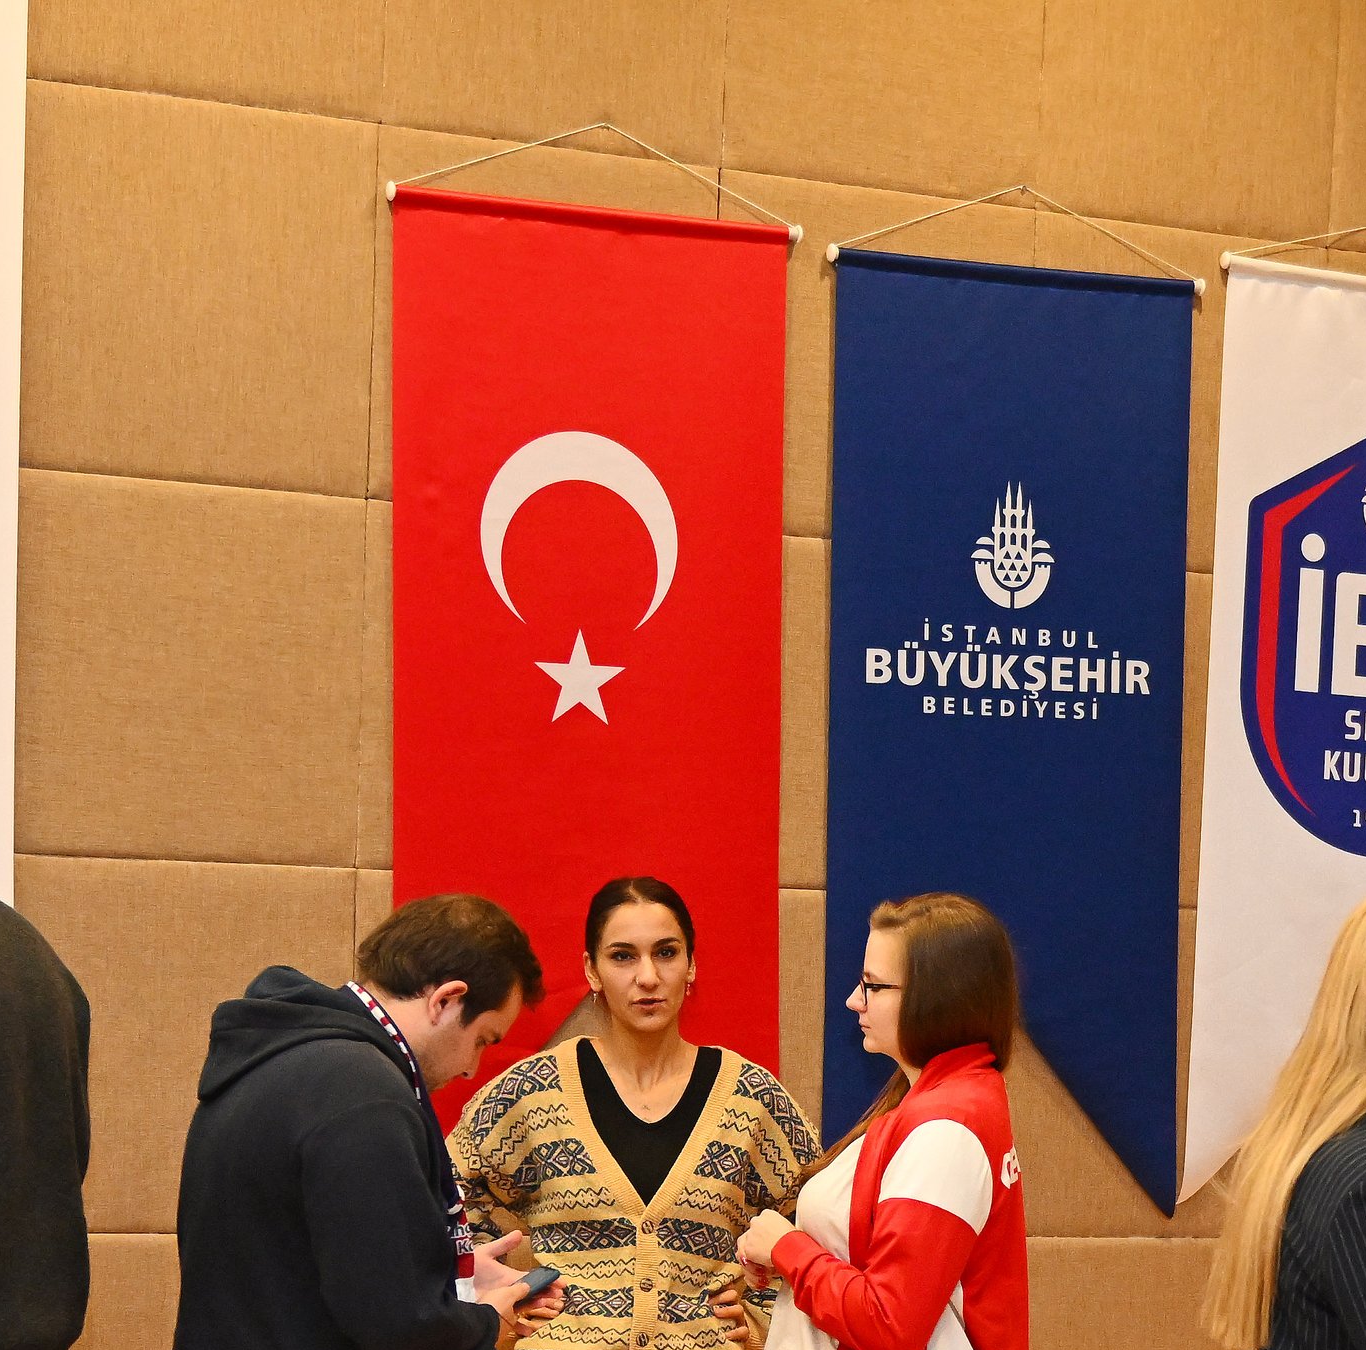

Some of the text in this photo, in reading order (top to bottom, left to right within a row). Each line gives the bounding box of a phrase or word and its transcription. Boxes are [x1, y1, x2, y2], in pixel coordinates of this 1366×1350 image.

[923, 617, 1099, 650] İSTANBUL
[865, 640, 1152, 699] BÜYÜKŞEHİR
[922, 695, 1099, 721] BELEDİYESİ
